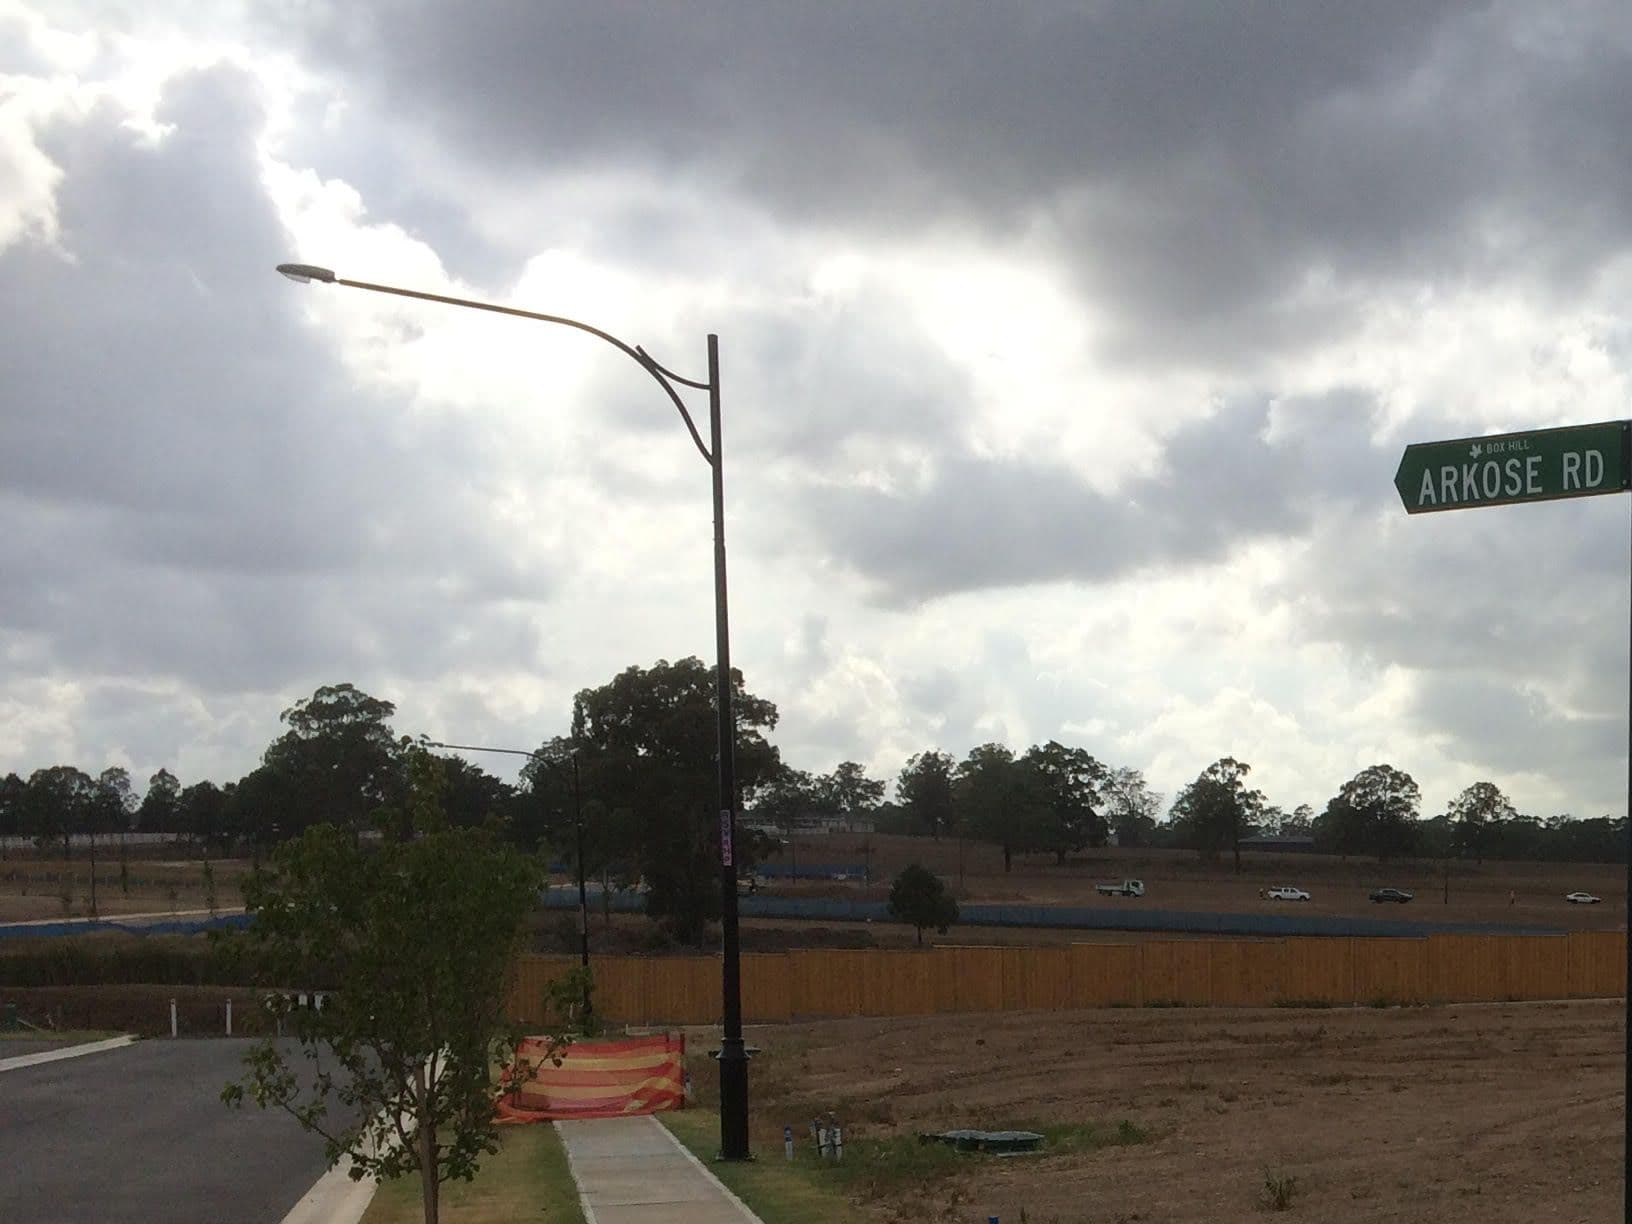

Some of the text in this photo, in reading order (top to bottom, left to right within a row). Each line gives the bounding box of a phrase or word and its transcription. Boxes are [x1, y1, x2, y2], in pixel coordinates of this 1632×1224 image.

[1486, 440, 1530, 454] BOX HILL
[1417, 449, 1604, 506] ARKOSE RD
